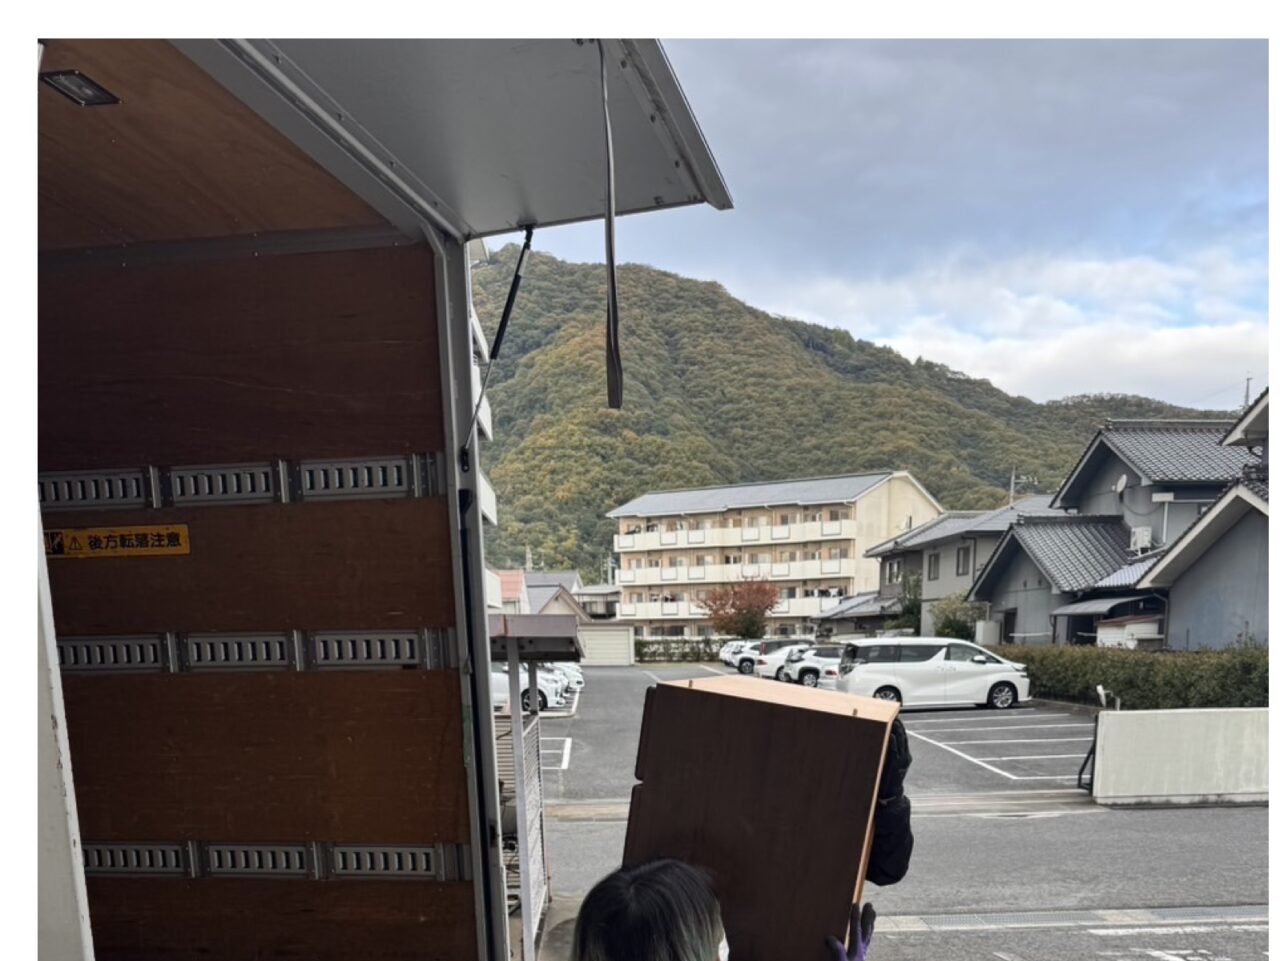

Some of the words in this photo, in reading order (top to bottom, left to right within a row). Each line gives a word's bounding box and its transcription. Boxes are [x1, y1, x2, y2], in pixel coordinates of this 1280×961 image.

[88, 531, 182, 551] 後方転落注意
